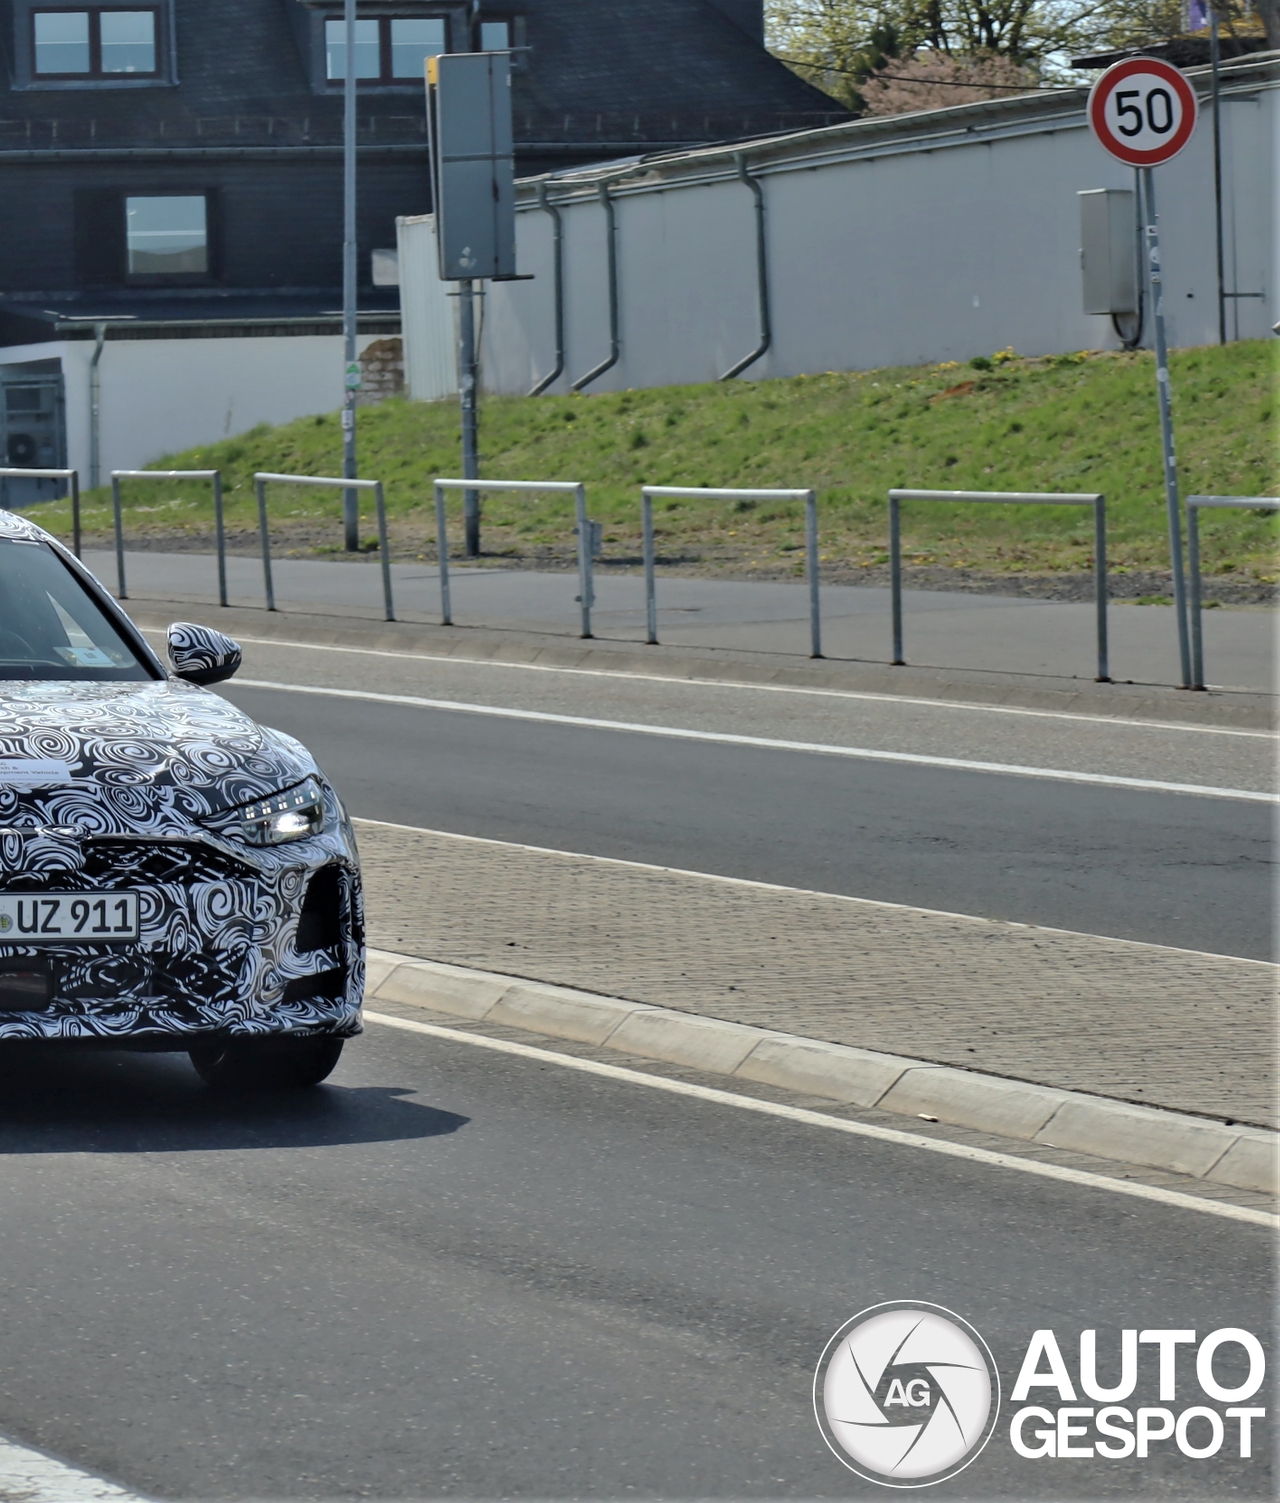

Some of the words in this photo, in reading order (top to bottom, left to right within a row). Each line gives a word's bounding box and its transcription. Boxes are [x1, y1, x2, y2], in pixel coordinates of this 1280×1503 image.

[1115, 87, 1174, 137] 50
[17, 899, 62, 934] UZ
[70, 899, 133, 933] 911
